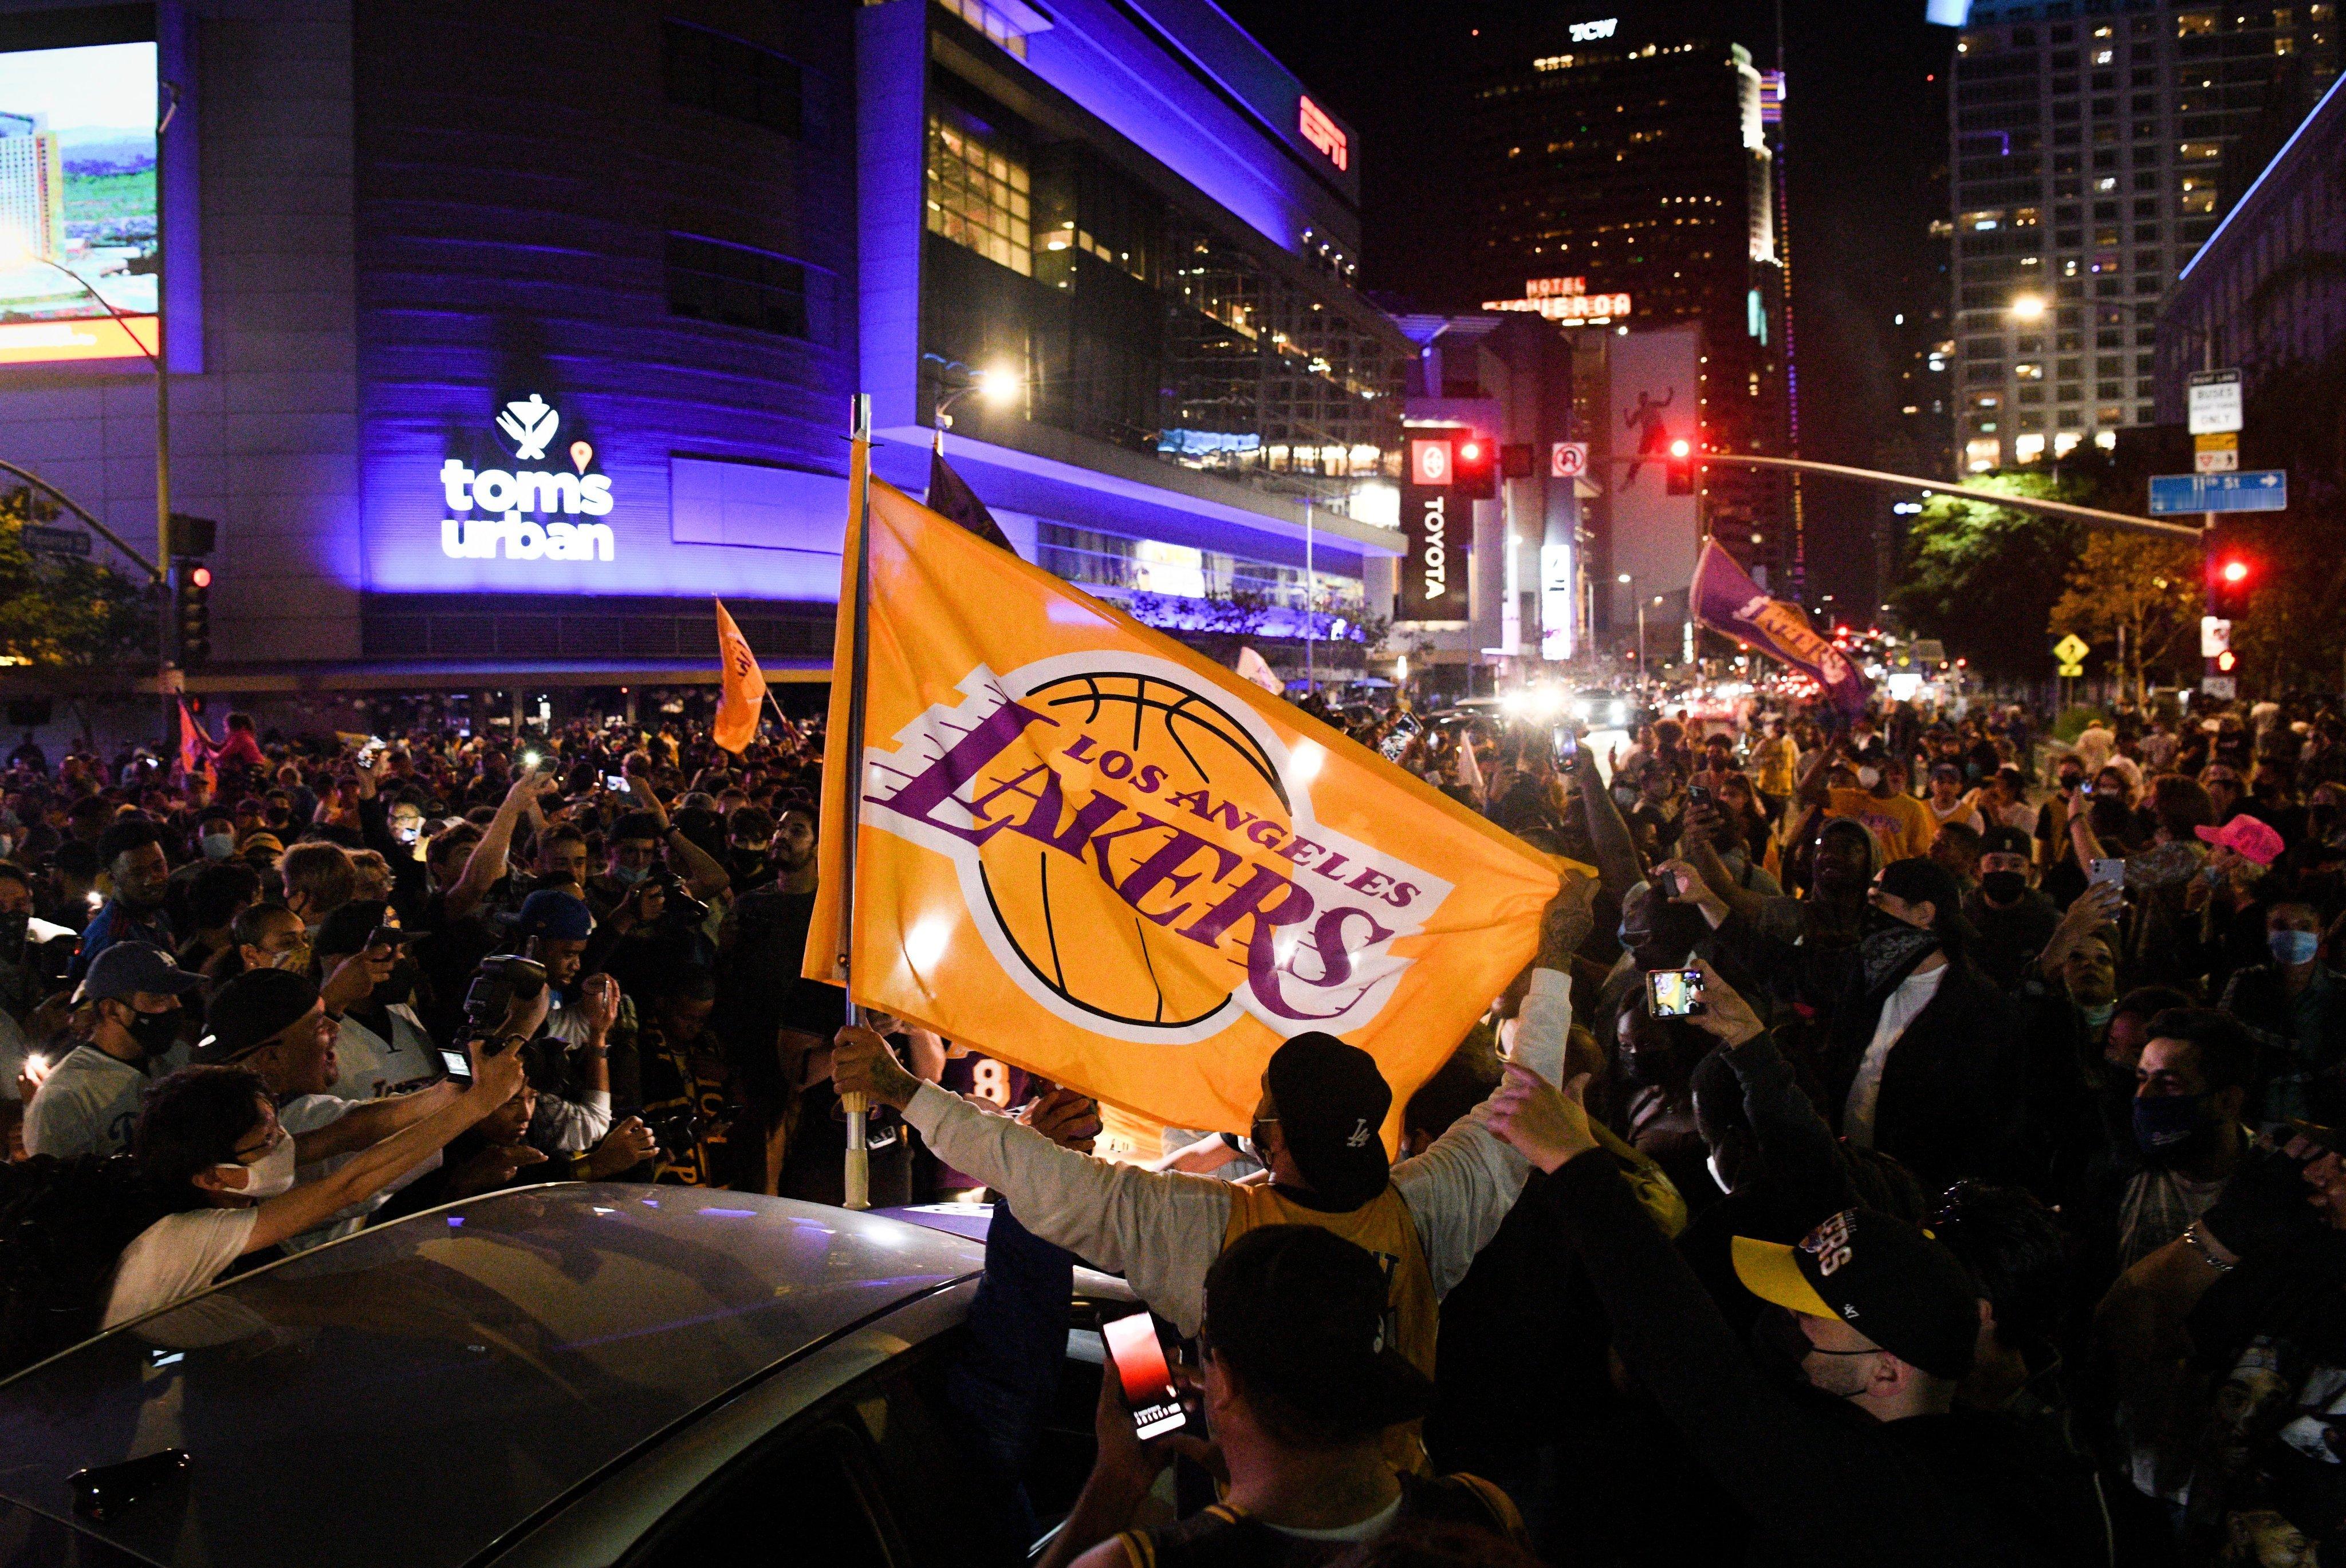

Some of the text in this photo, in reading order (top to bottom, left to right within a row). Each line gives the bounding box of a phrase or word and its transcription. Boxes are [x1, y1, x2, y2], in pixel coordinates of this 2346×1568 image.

[1569, 18, 1617, 42] TCW
[1300, 94, 1347, 171] ESPN
[1526, 276, 1585, 297] HOTEL
[440, 459, 613, 516] toms
[441, 510, 614, 561] urban
[1424, 496, 1446, 600] TOYOTA
[1062, 735, 1422, 908] LOS ANGELES
[863, 681, 1395, 1021] LAKERS
[973, 1059, 1011, 1109] 8
[1347, 1118, 1371, 1148] LA
